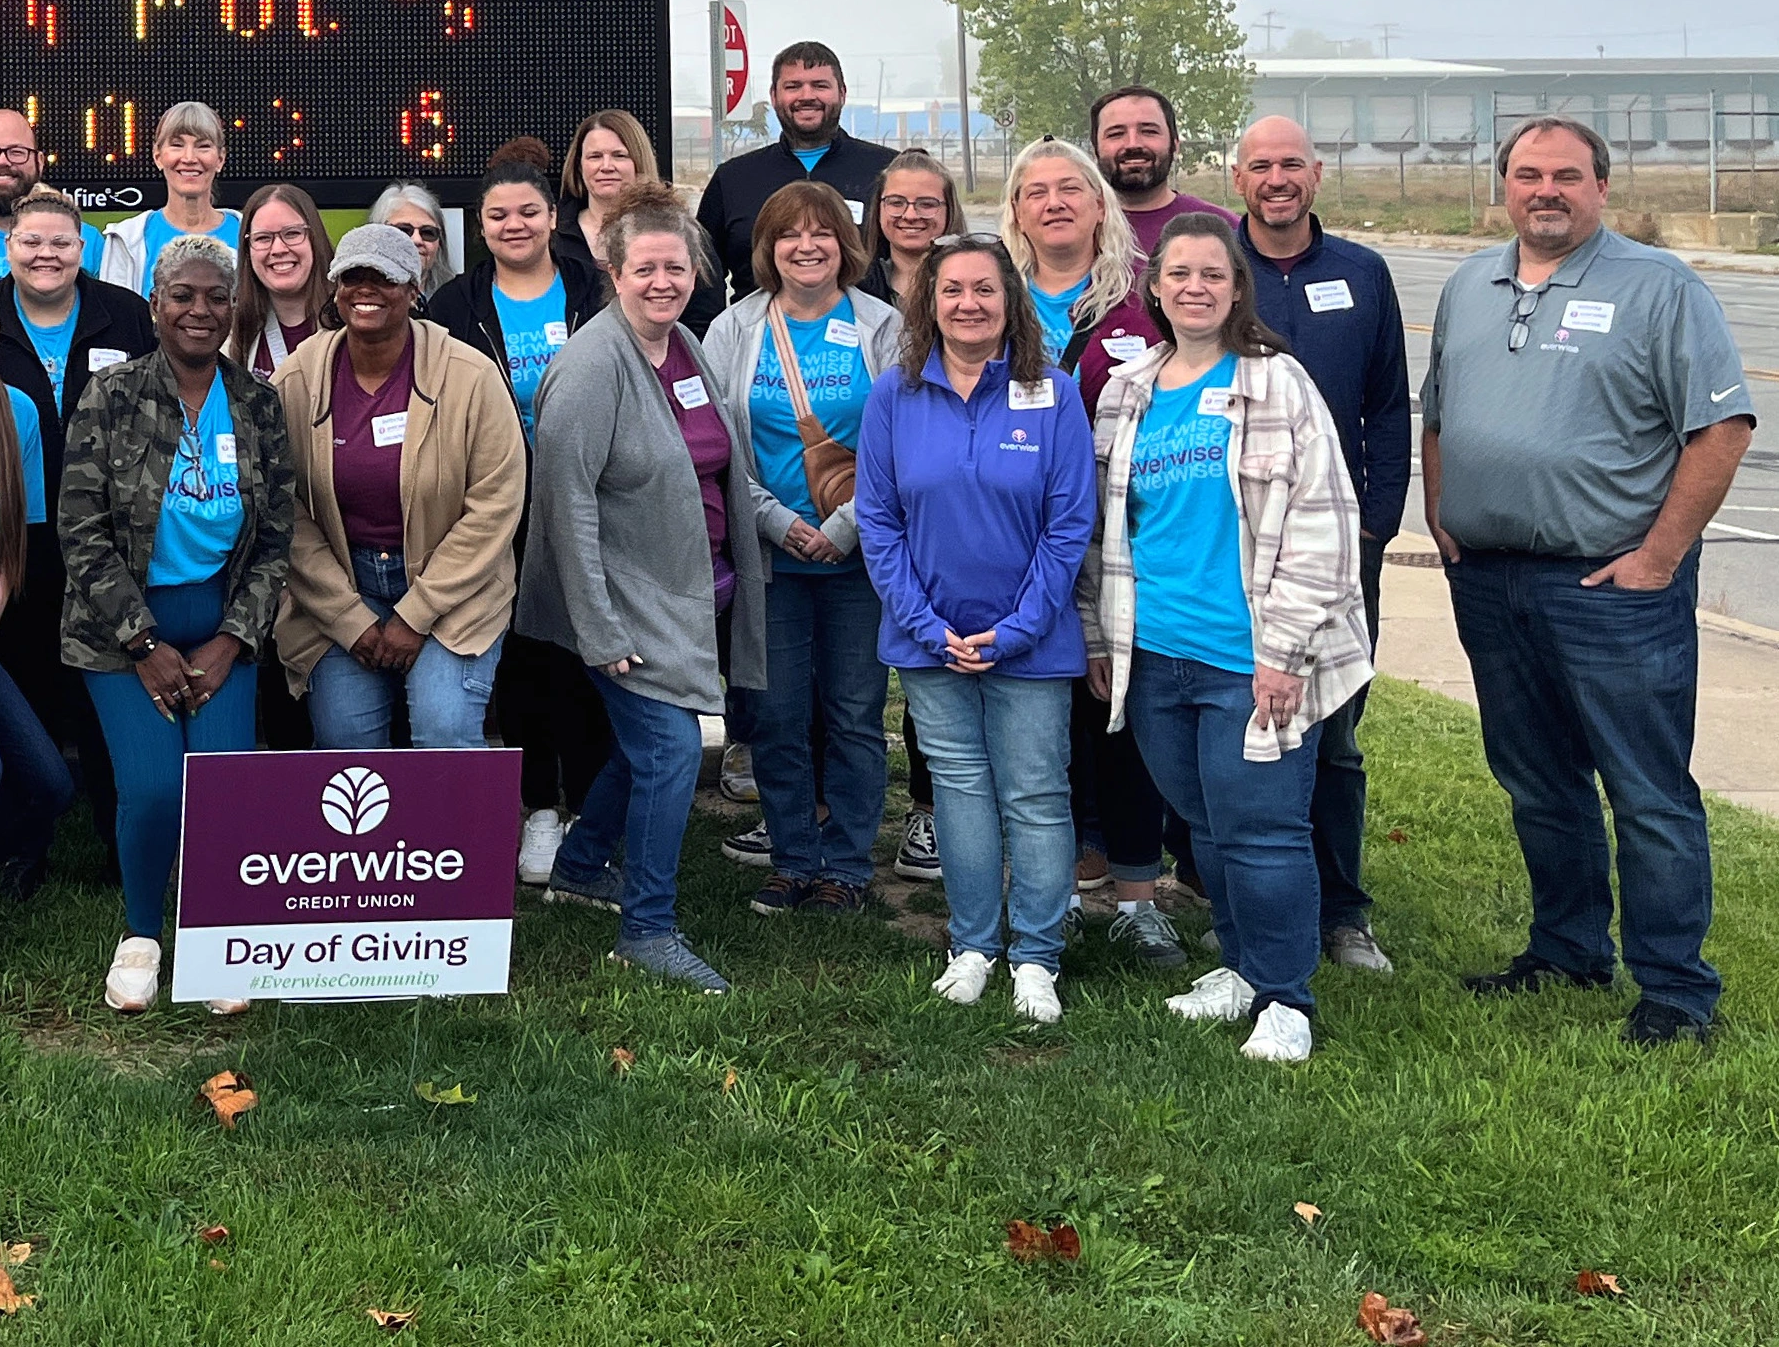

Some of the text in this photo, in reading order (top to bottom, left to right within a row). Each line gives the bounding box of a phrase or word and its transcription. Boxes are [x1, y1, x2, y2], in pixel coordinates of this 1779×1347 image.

[753, 374, 852, 391] evewise
[750, 386, 853, 402] evewise
[164, 496, 238, 520] verwis
[240, 840, 464, 885] everwise
[285, 894, 415, 910] CREDIT UNION
[225, 931, 469, 970] Day of Giving
[249, 970, 440, 989] #EverwiseCommunity
